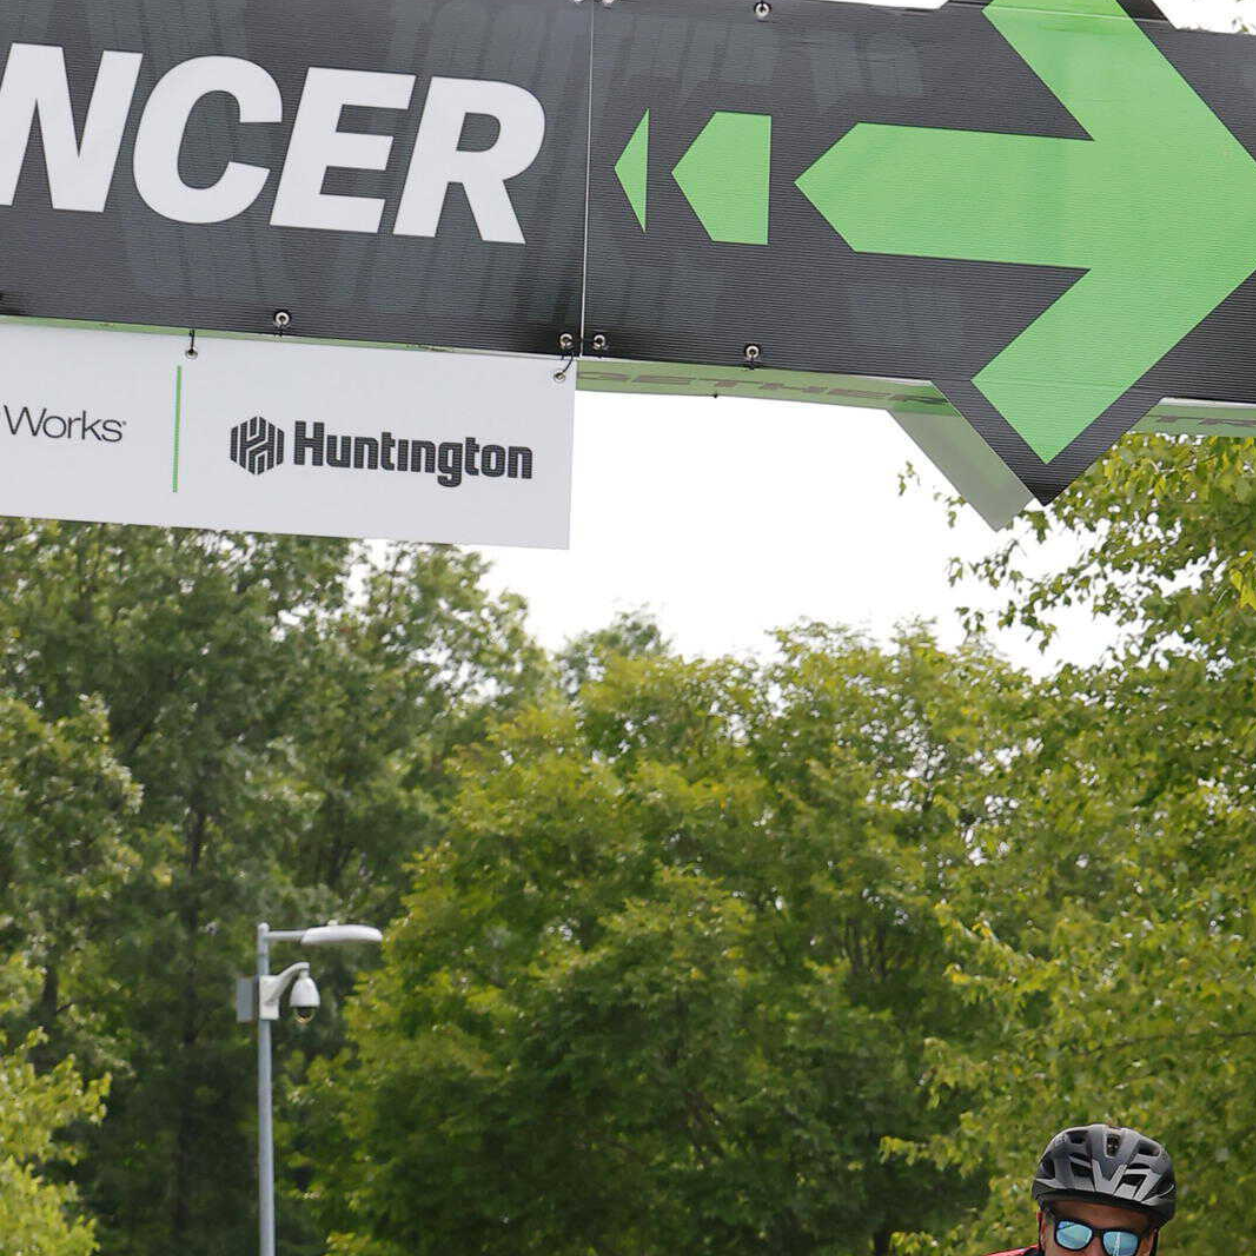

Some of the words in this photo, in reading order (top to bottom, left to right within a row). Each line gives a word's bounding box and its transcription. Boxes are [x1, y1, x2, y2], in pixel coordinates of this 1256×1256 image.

[0, 42, 546, 245] NCER
[3, 404, 123, 442] Works
[293, 419, 533, 488] Huntington
